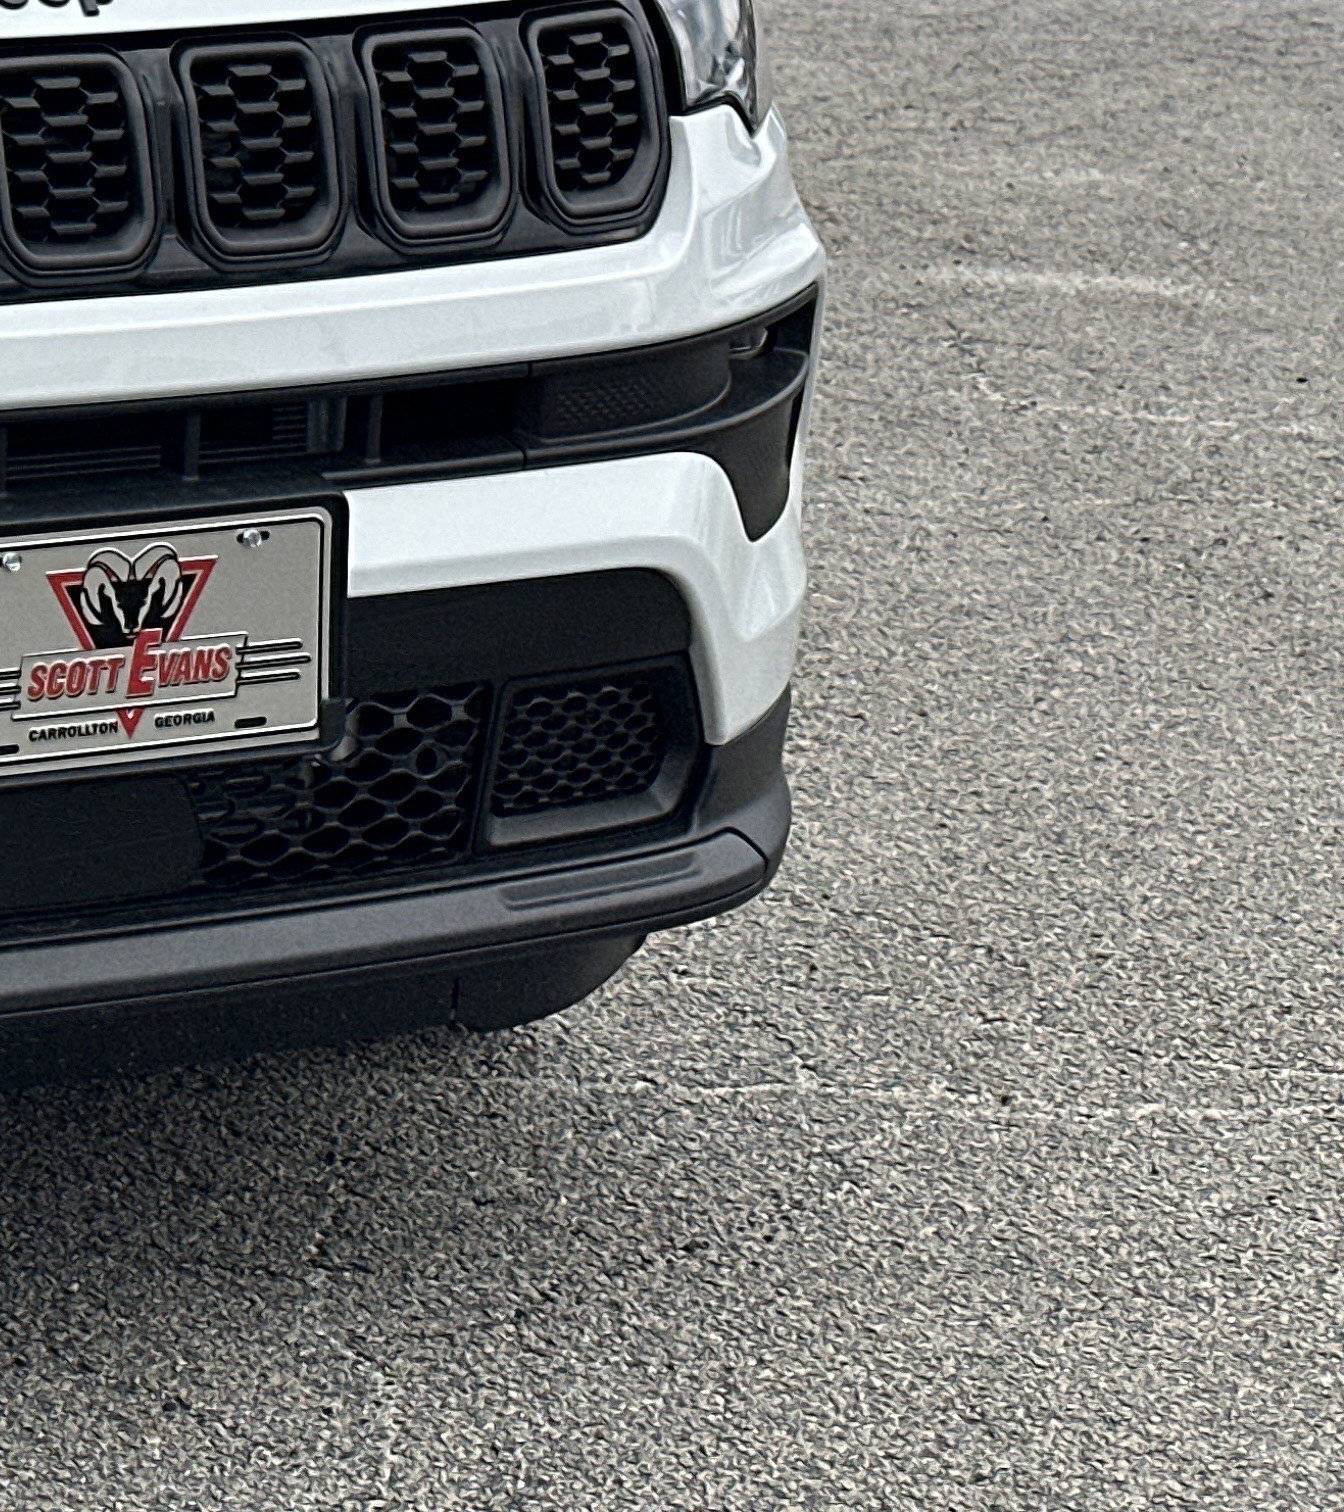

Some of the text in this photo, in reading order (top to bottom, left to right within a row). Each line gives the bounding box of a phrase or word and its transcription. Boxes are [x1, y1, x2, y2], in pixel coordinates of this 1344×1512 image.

[27, 628, 233, 702] SCOTT EVANS
[28, 710, 217, 742] CARROLLTON GEORGIA
